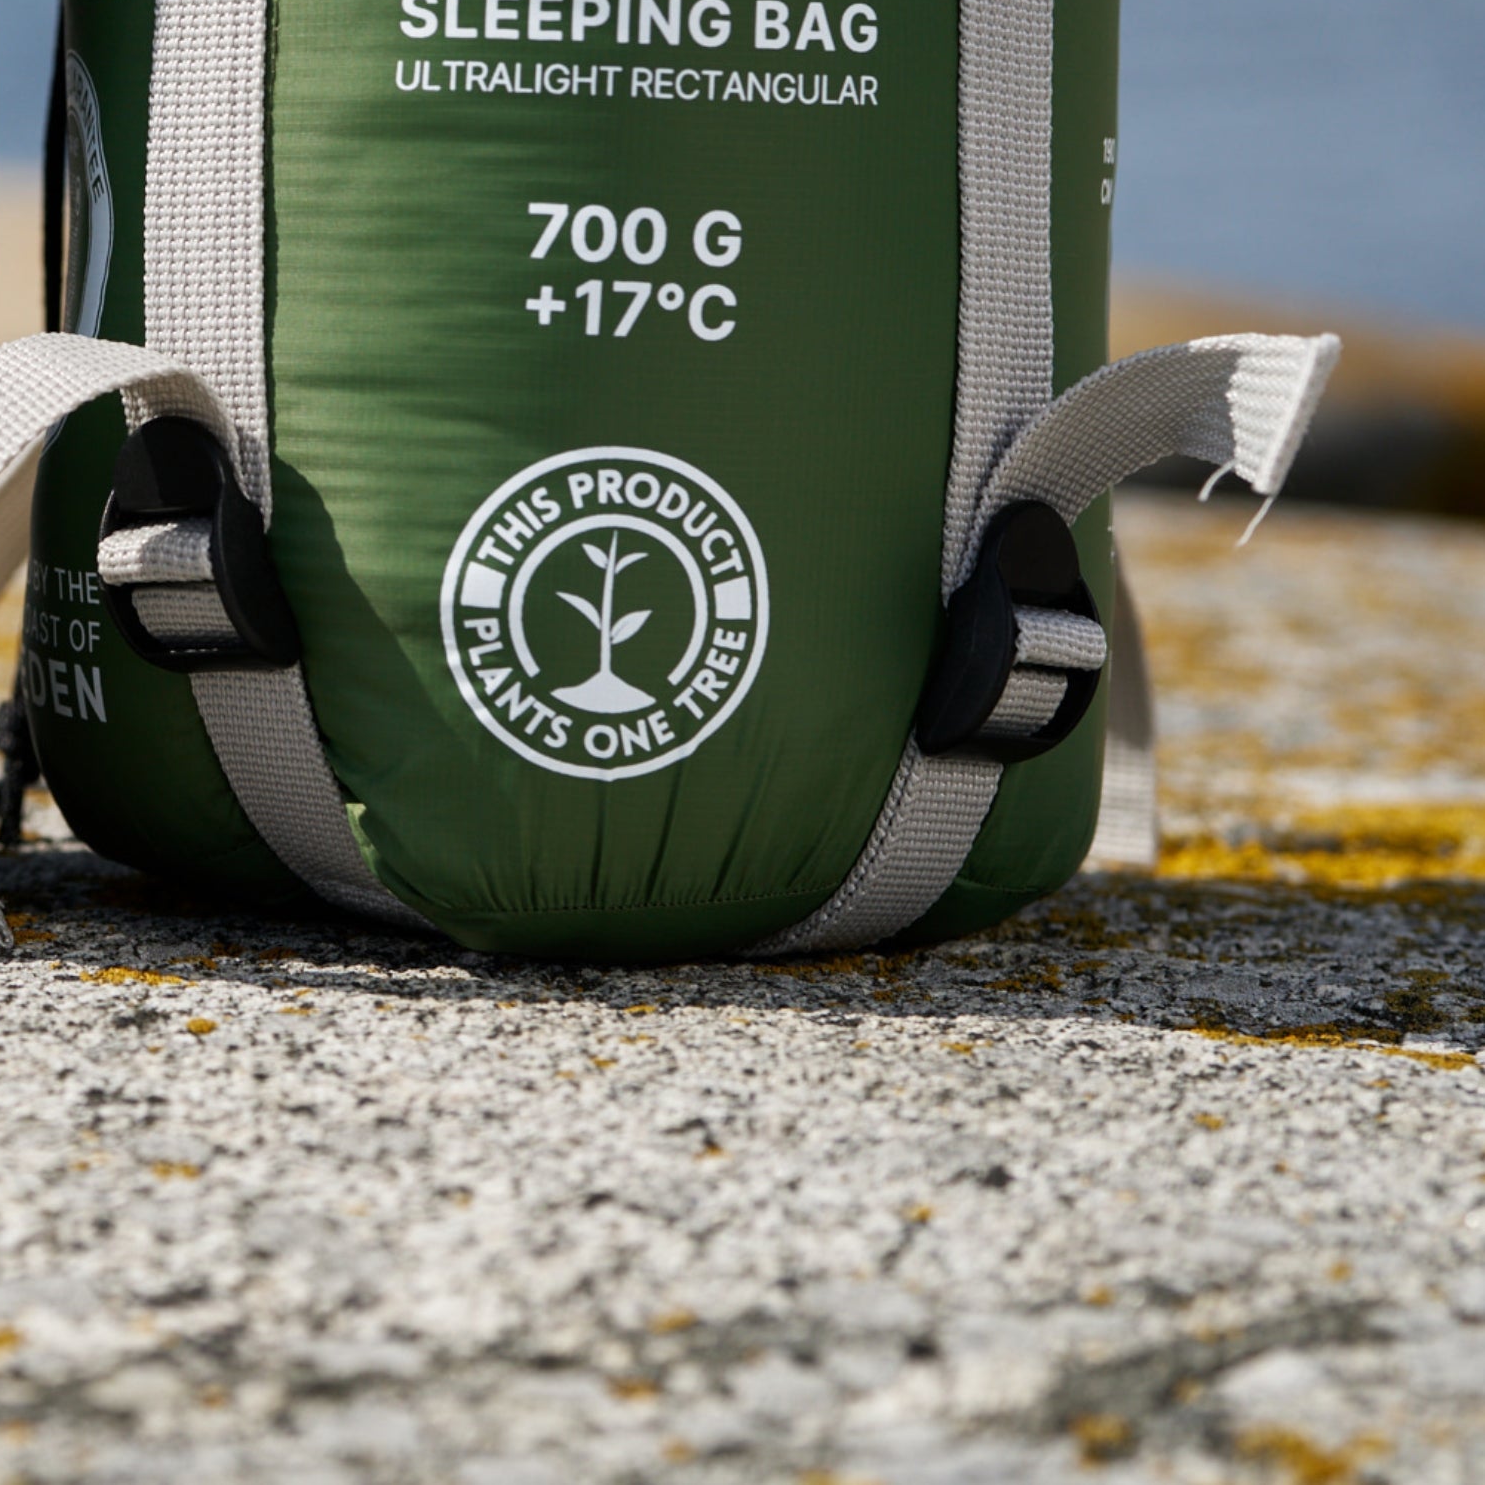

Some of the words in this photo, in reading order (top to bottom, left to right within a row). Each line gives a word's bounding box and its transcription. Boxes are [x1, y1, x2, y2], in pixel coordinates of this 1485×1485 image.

[754, 0, 879, 53] BAG
[395, 60, 622, 97] ULTRALIGHT
[630, 67, 879, 107] RECTANGULAR
[527, 202, 667, 266] 700
[692, 209, 743, 268] G
[525, 279, 738, 342] +17°C
[477, 487, 561, 567] THIS
[568, 468, 745, 576] PRODUCT
[54, 567, 100, 605] THE
[69, 618, 101, 653] OF
[463, 617, 573, 749] PLANTS
[584, 710, 676, 759] ONE
[673, 627, 747, 720] TREE
